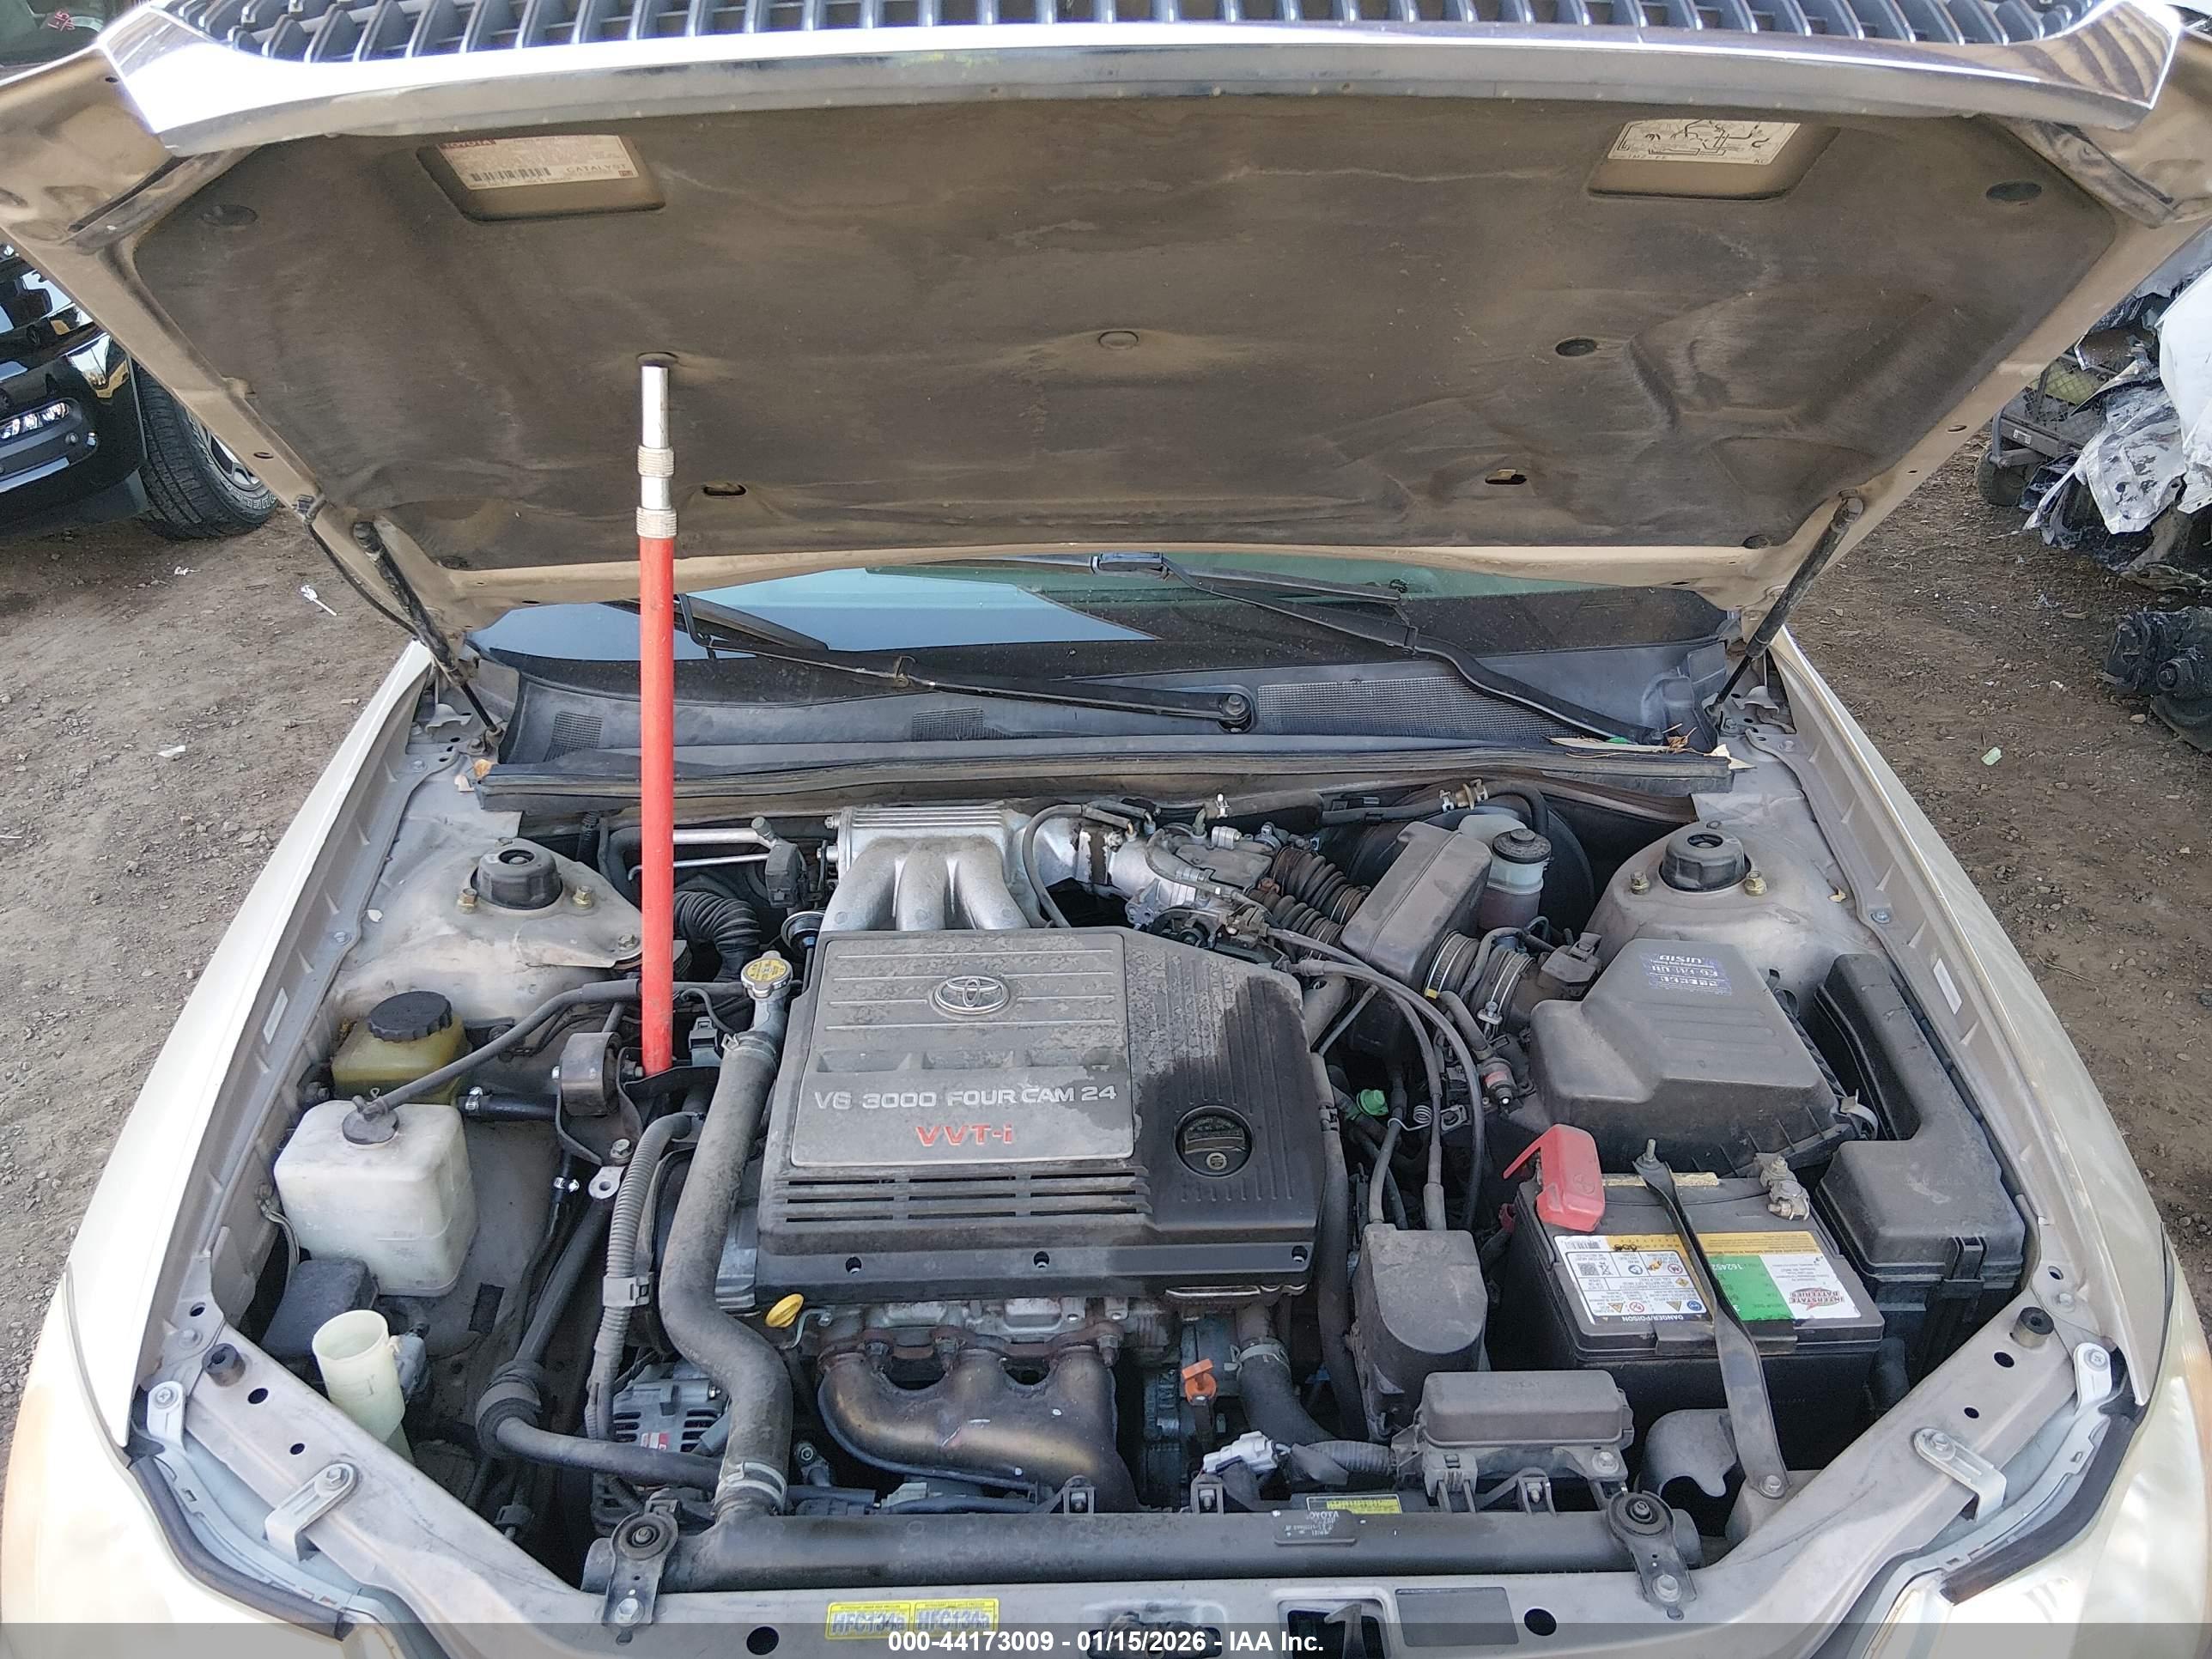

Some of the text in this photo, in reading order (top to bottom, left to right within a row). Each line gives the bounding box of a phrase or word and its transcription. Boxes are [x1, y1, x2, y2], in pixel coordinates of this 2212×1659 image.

[566, 163, 627, 173] CATALYST
[1659, 954, 1702, 964] AISIN
[813, 1084, 1118, 1110] V6 3000 FOUR CAM 24
[915, 1122, 1015, 1148] VVT-i
[1790, 1288, 1841, 1298] BATTERIES
[1789, 1294, 1845, 1305] INTERSTATE
[1621, 1314, 1684, 1323] DANGER/POISON
